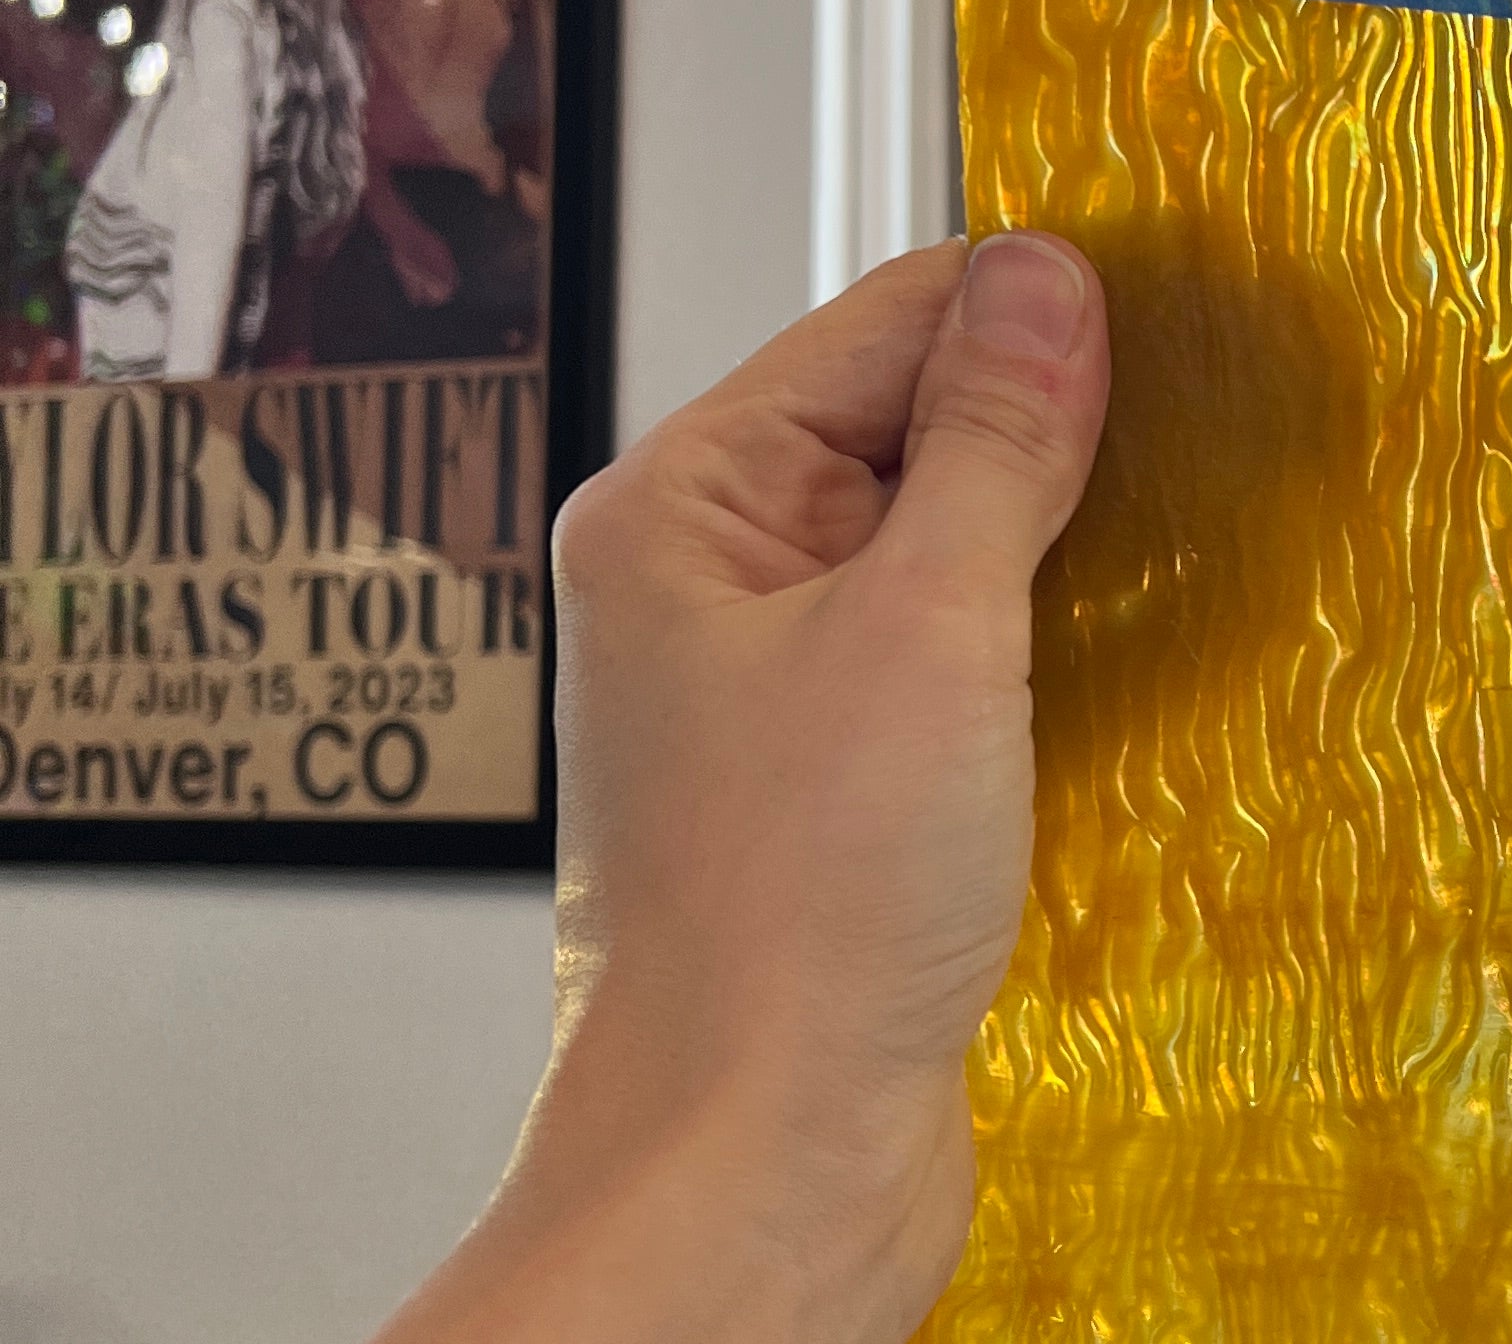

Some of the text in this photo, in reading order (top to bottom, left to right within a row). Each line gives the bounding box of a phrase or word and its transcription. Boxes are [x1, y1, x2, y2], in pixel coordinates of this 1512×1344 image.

[239, 373, 543, 563] SWIFT
[57, 570, 267, 663] ERAS
[290, 566, 537, 658] TOUR
[134, 667, 232, 726] July
[328, 662, 456, 715] 2023
[292, 718, 429, 808] CO
